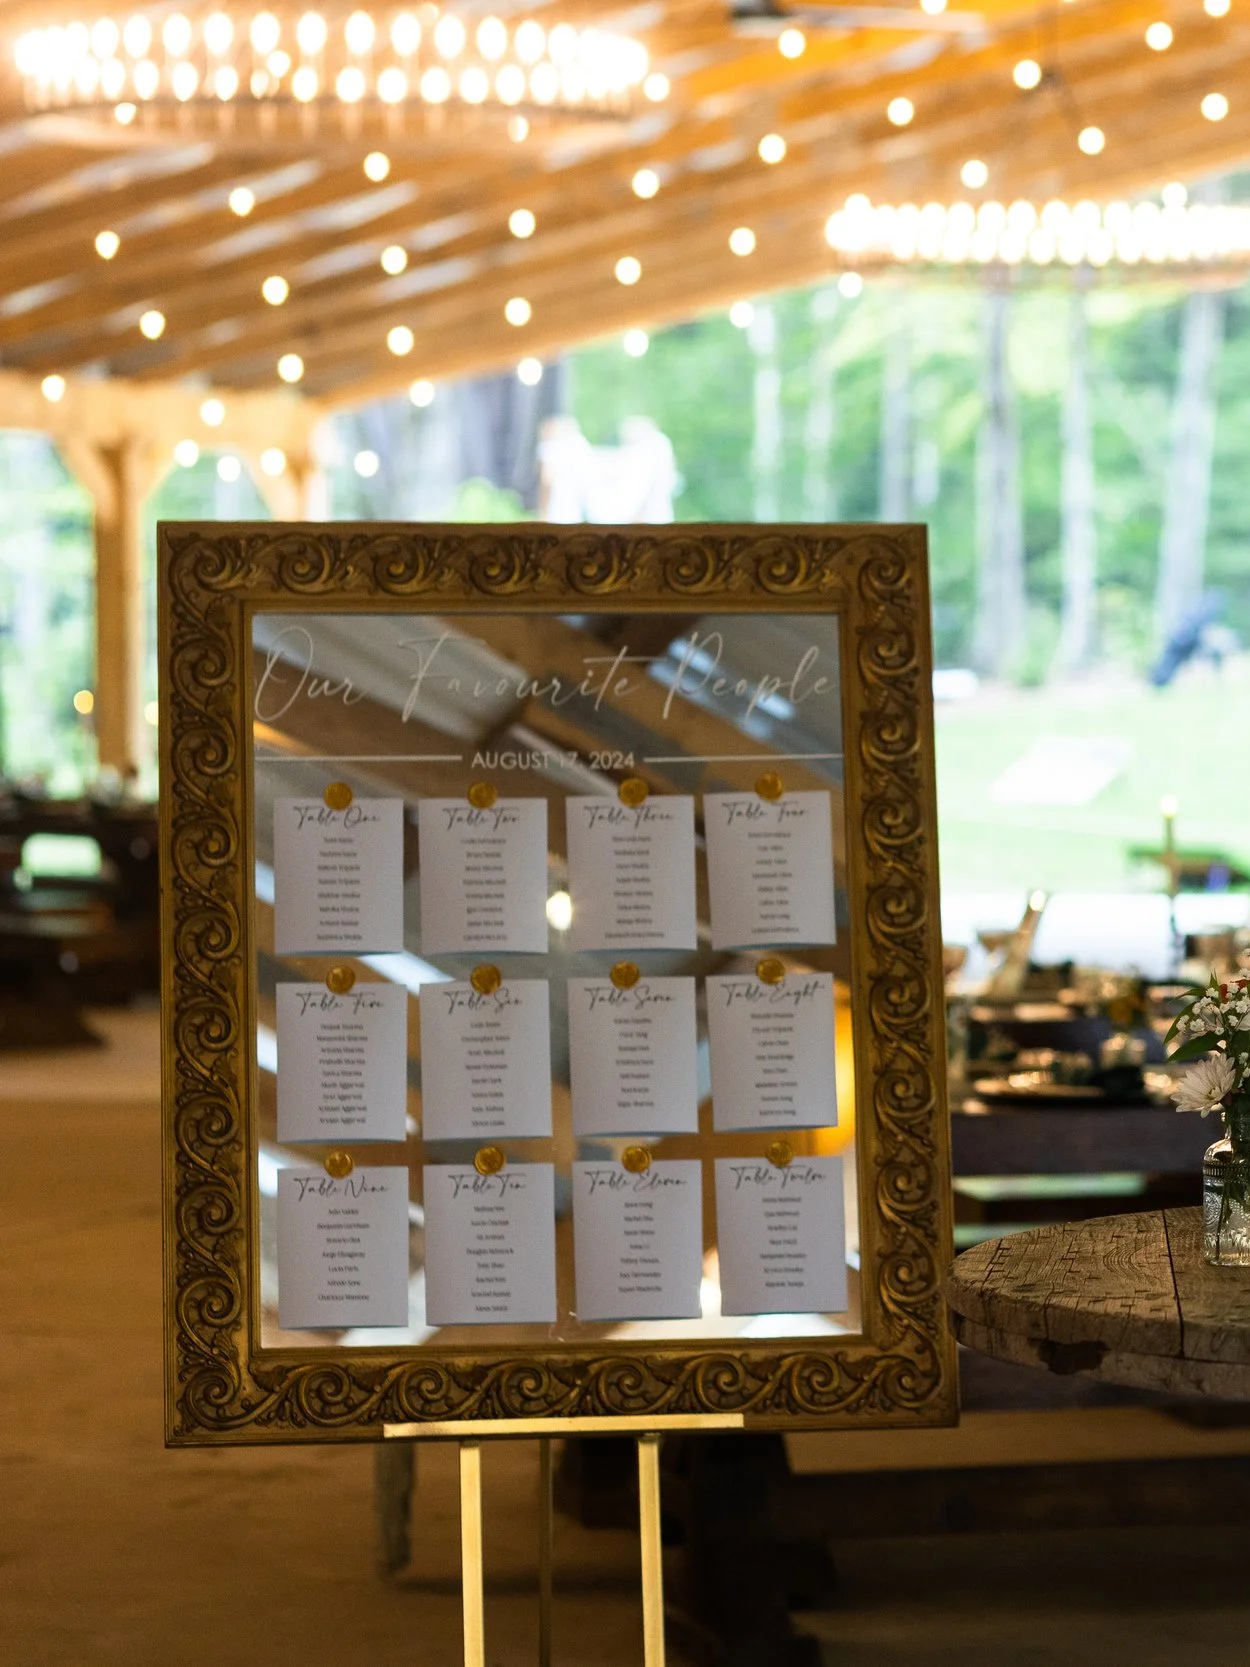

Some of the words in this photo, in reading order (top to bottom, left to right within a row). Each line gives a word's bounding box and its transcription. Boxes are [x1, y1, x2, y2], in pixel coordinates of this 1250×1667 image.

[255, 625, 362, 722] Our
[398, 631, 667, 723] Favourite
[662, 631, 835, 726] People
[471, 750, 549, 770] AUGUST
[589, 750, 635, 770] 2024
[294, 805, 340, 829] Table
[344, 806, 380, 829] One
[442, 808, 488, 831] Table
[489, 808, 519, 831] Two
[584, 805, 630, 829] Table
[632, 805, 672, 829] Three
[722, 801, 768, 826] Table
[772, 801, 806, 823] Four
[296, 992, 342, 1017] Table
[347, 992, 383, 1015] Five
[444, 990, 490, 1014] Table
[494, 987, 523, 1014] Six
[585, 986, 630, 1010] Table
[634, 985, 676, 1010] Seven
[721, 983, 767, 1006] Table
[294, 1177, 340, 1202] Table
[344, 1175, 390, 1199] Nine
[448, 1174, 494, 1199] Table
[496, 1173, 526, 1198] Ten
[585, 1170, 631, 1195] Table
[632, 1170, 687, 1192] Eleven
[730, 1166, 776, 1190] Table
